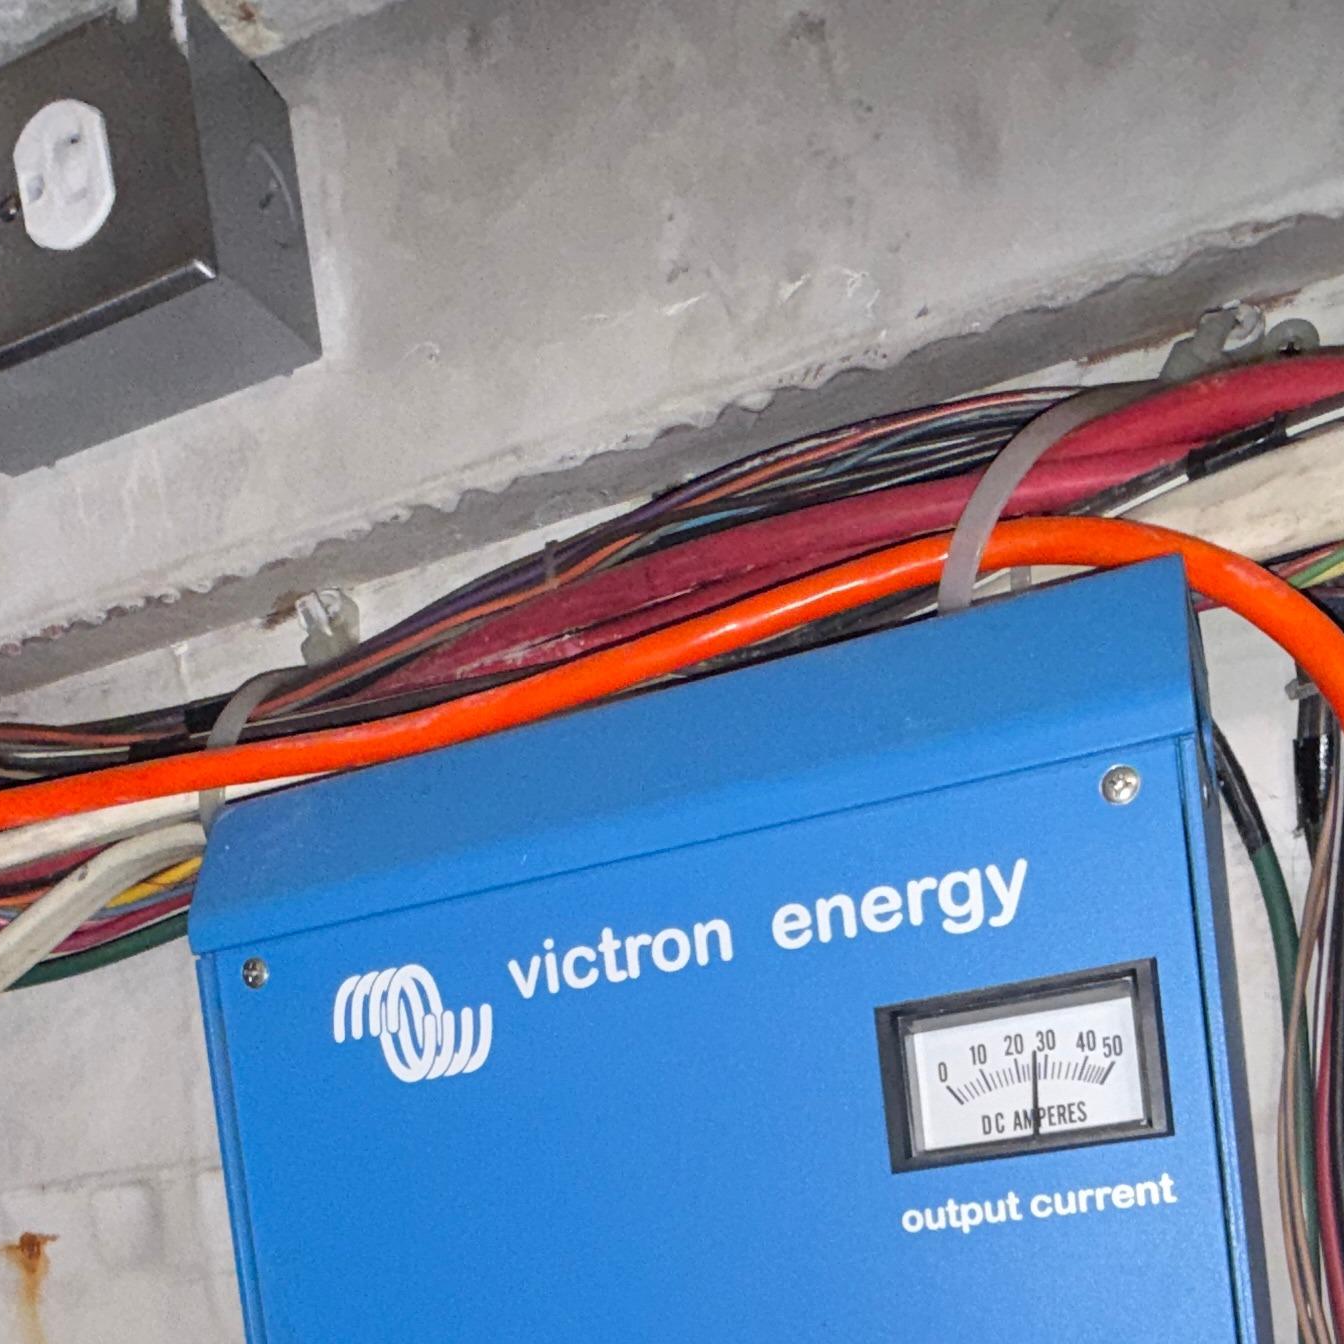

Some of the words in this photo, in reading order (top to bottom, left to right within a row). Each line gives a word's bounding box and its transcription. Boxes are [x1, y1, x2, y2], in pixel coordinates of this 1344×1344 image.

[507, 917, 733, 999] victron
[771, 858, 1028, 951] energy
[938, 1062, 948, 1083] 0
[969, 1043, 987, 1066] 10
[1003, 1033, 1024, 1057] 20
[1035, 1029, 1056, 1053] 30
[1076, 1029, 1097, 1053] 40
[1102, 1034, 1123, 1059] 50
[982, 1112, 1005, 1135] DC
[1013, 1101, 1087, 1131] AMPERES
[902, 1191, 1022, 1234] output
[1029, 1173, 1177, 1219] current
